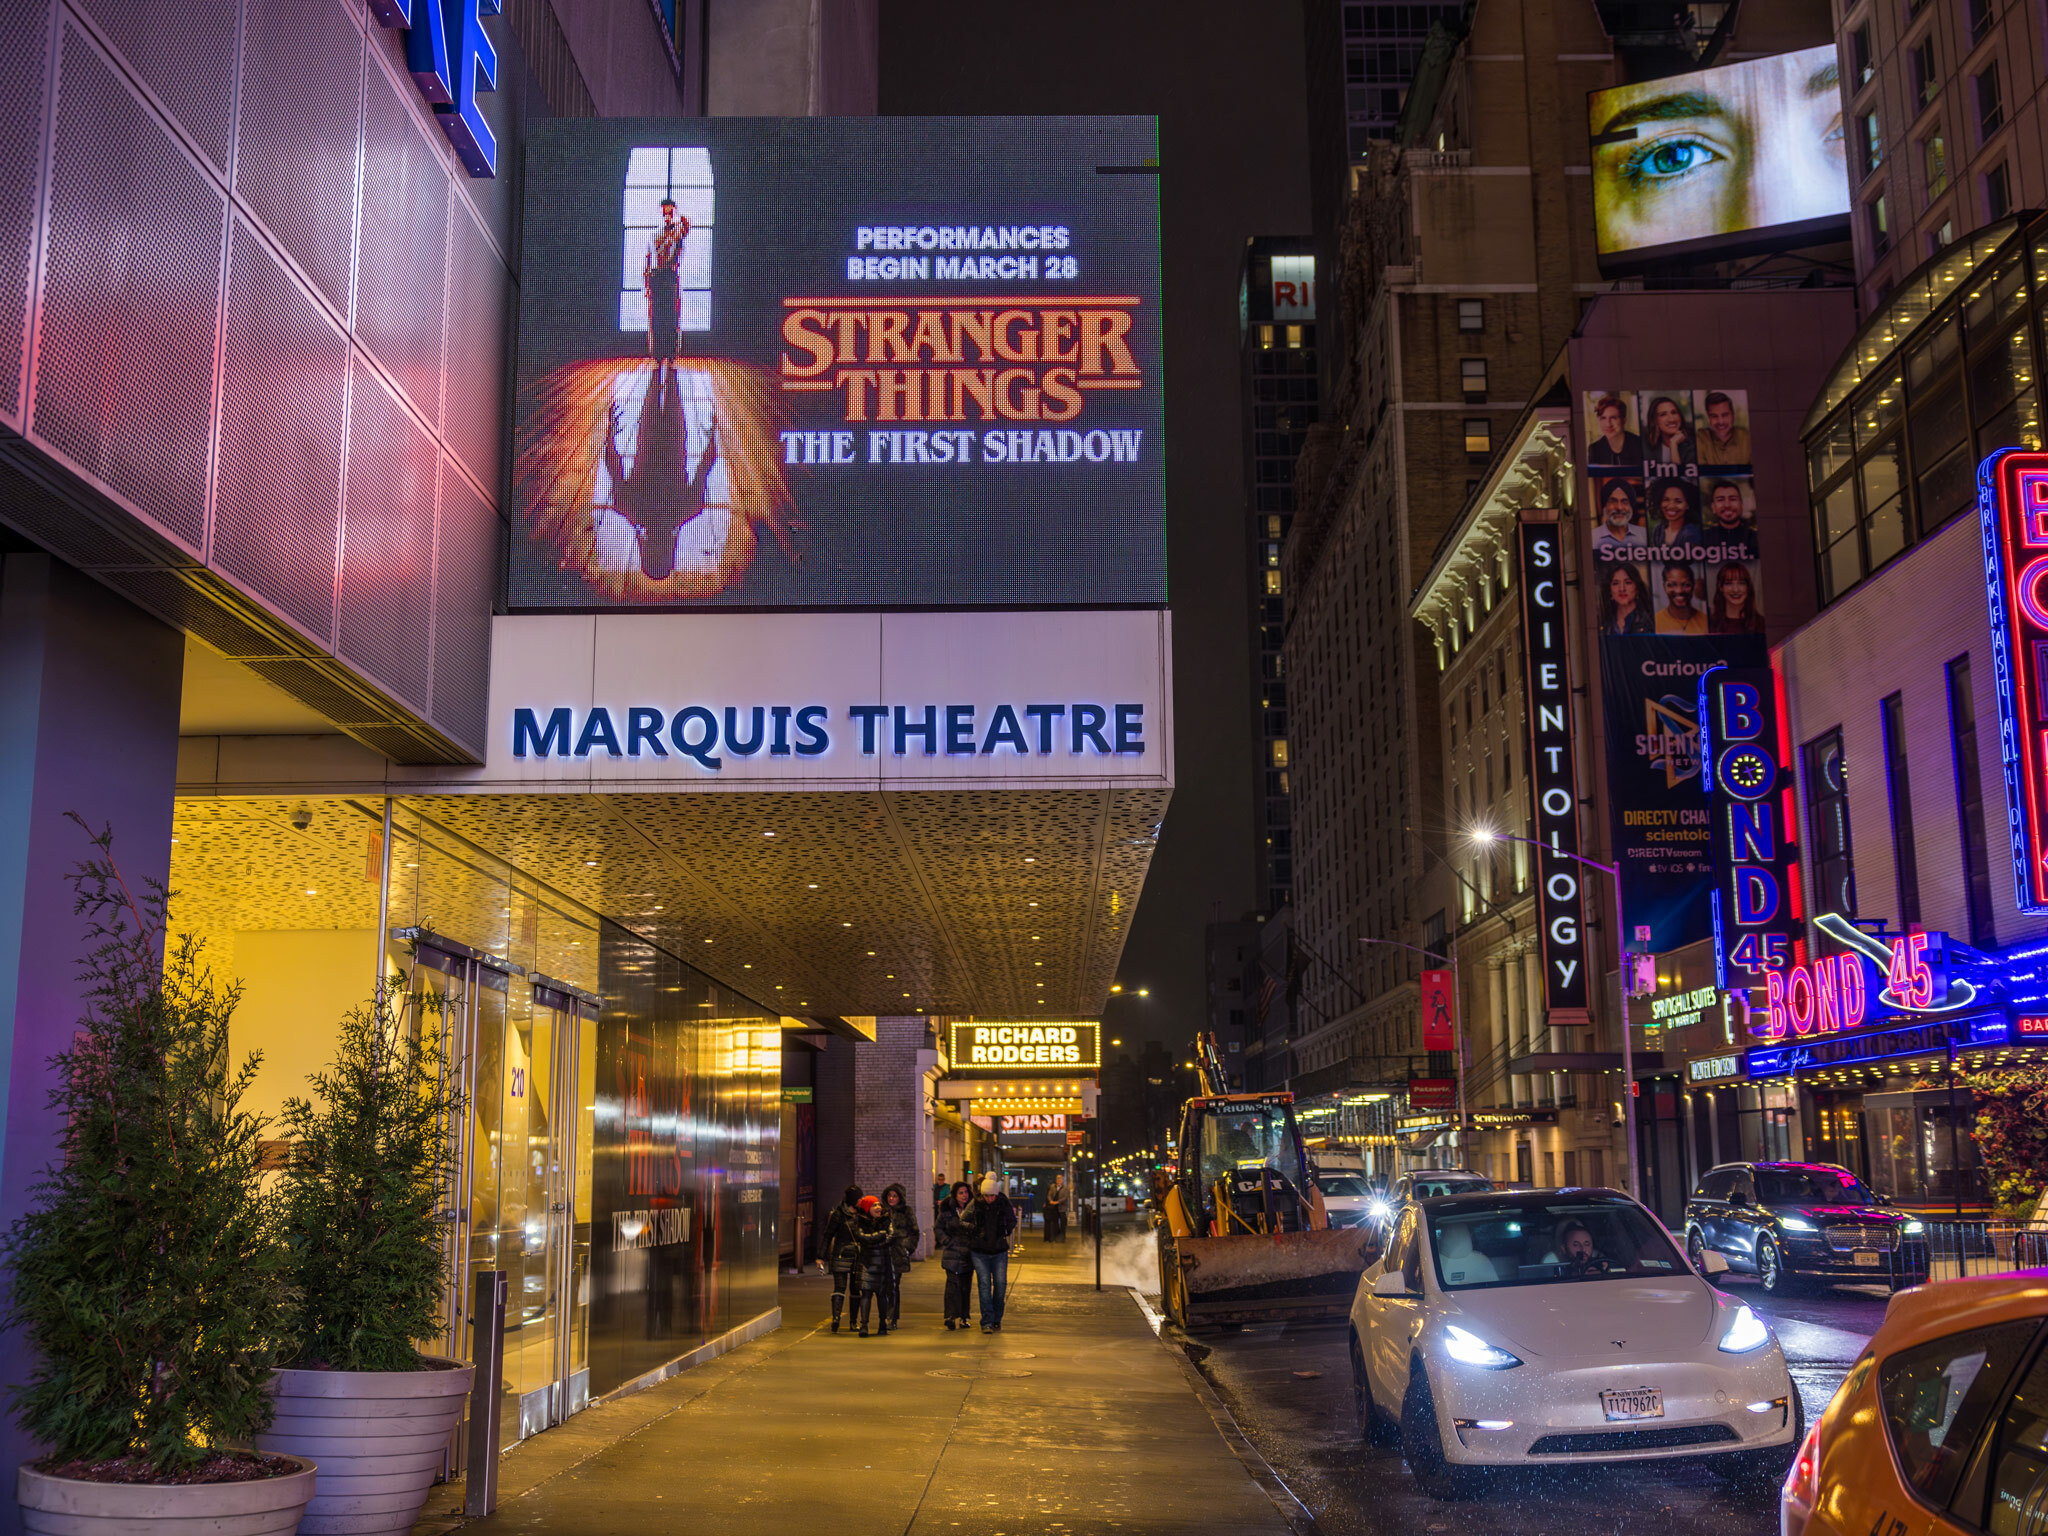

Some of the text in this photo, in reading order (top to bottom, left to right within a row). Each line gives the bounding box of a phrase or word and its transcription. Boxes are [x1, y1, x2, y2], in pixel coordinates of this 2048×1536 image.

[857, 226, 1069, 250] PERFORMANCES
[847, 257, 1078, 280] BEGIN MARCH 28
[1274, 281, 1315, 307] RI
[781, 309, 1142, 377] STRANGER
[836, 368, 1083, 422] THINGS
[781, 429, 1142, 463] THE FIRST SHADOW
[1643, 460, 1698, 478] I'm a
[1600, 542, 1754, 564] Scientologist.
[1980, 487, 2026, 878] BREAKFAST ALL DAY
[513, 704, 1145, 769] MARQUIS THEATRE
[1533, 540, 1577, 989] SCIENTOLOGY
[1624, 810, 1678, 826] DIRECTV
[1718, 682, 1780, 926] BOND
[1730, 933, 1789, 975] 45
[1766, 951, 1865, 1039] BOND
[1888, 933, 1933, 1009] 45
[1651, 986, 1717, 1020] SPRINGHILL SUITES
[975, 1028, 1077, 1045] RICHARD
[972, 1046, 1080, 1063] RODGERS
[1691, 1057, 1737, 1080] HOTEL EDISON
[511, 1066, 525, 1098] 210
[1001, 1113, 1066, 1129] SMASH
[1215, 1104, 1272, 1114] TRIUMPH
[659, 1207, 692, 1247] SHADOW
[1608, 1396, 1658, 1413] T127962C
